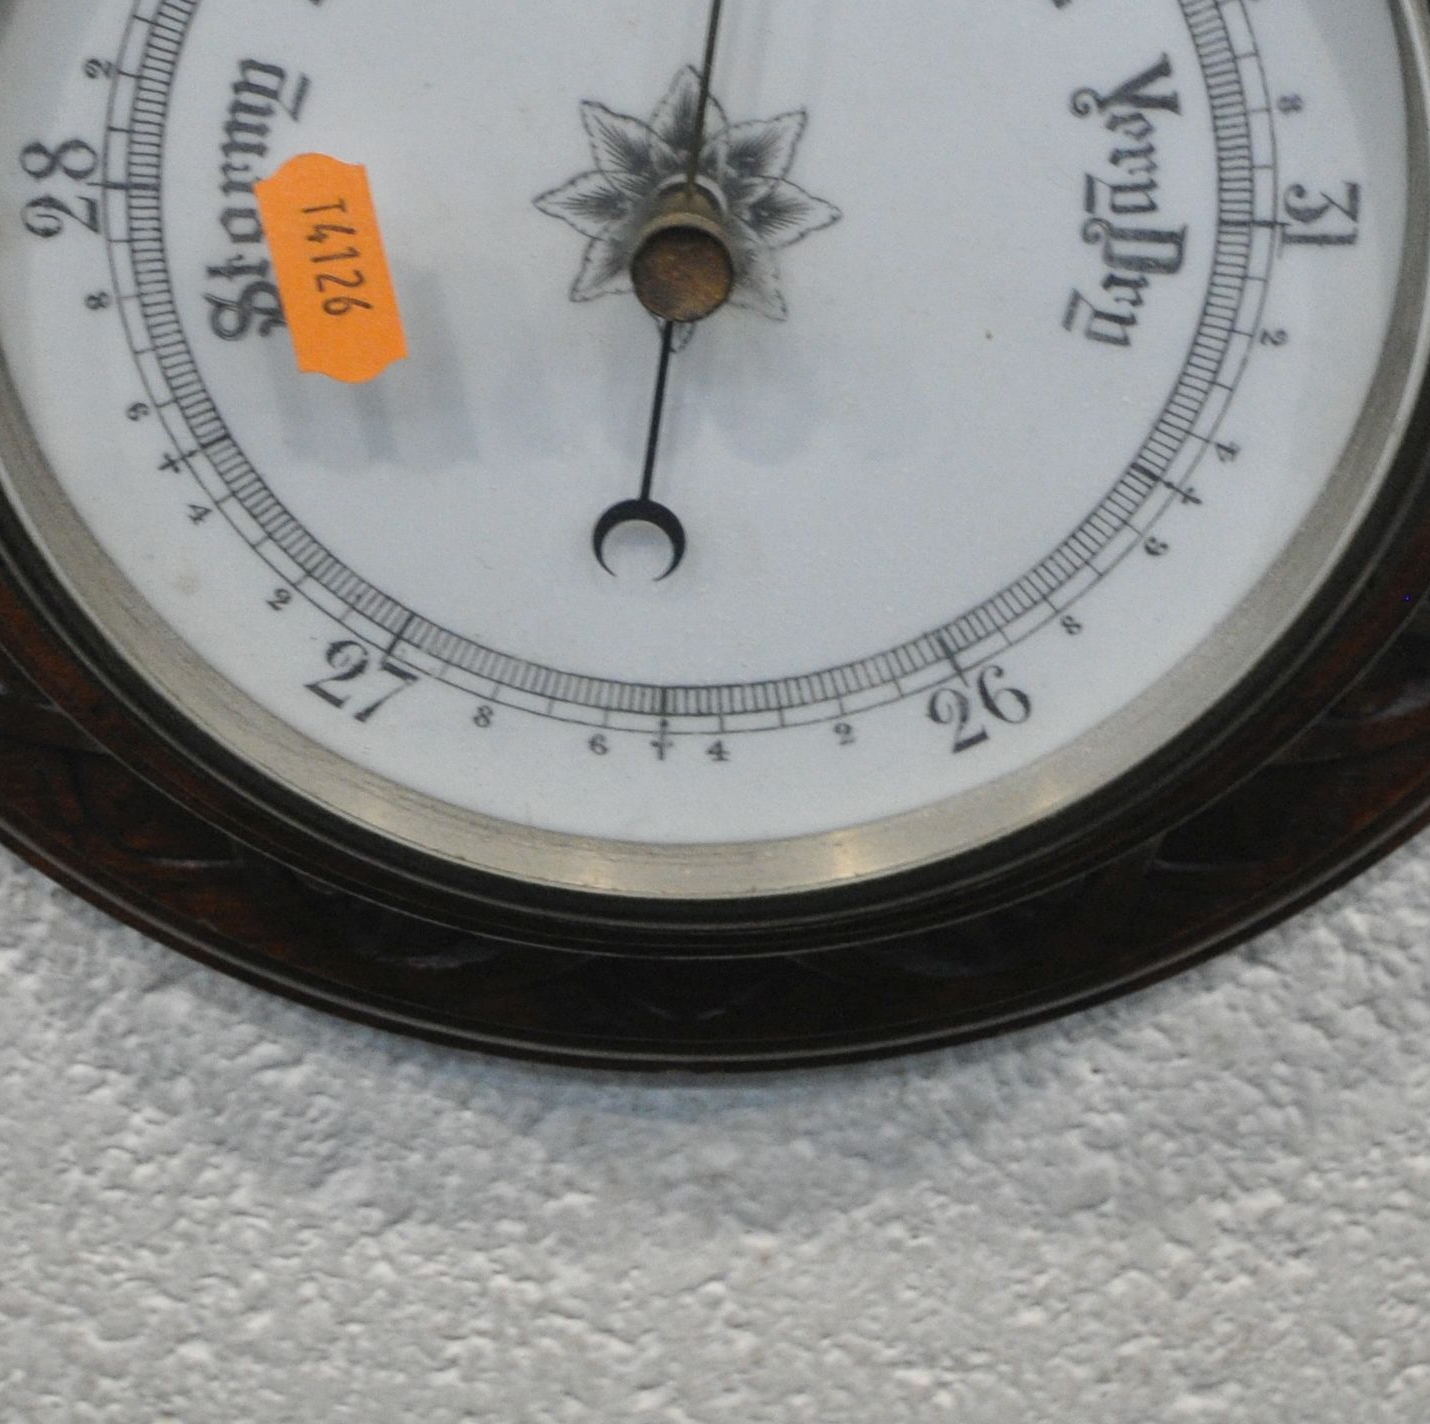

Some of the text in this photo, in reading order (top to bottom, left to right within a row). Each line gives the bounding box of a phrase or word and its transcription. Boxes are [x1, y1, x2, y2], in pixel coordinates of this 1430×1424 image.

[82, 58, 114, 79] 2
[19, 138, 101, 239] 28
[202, 57, 312, 342] Stormy
[1059, 51, 1188, 347] Very Dry
[1277, 181, 1361, 260] 31
[301, 197, 375, 317] T4126
[1259, 328, 1289, 347] 2
[1212, 440, 1241, 464] 4
[186, 501, 214, 526] 4
[265, 587, 293, 611] 2
[303, 638, 421, 725] 27
[471, 704, 494, 729] 8
[925, 663, 1033, 755] 26
[587, 733, 610, 757] 6
[832, 721, 856, 747] 2
[705, 739, 731, 762] 4
